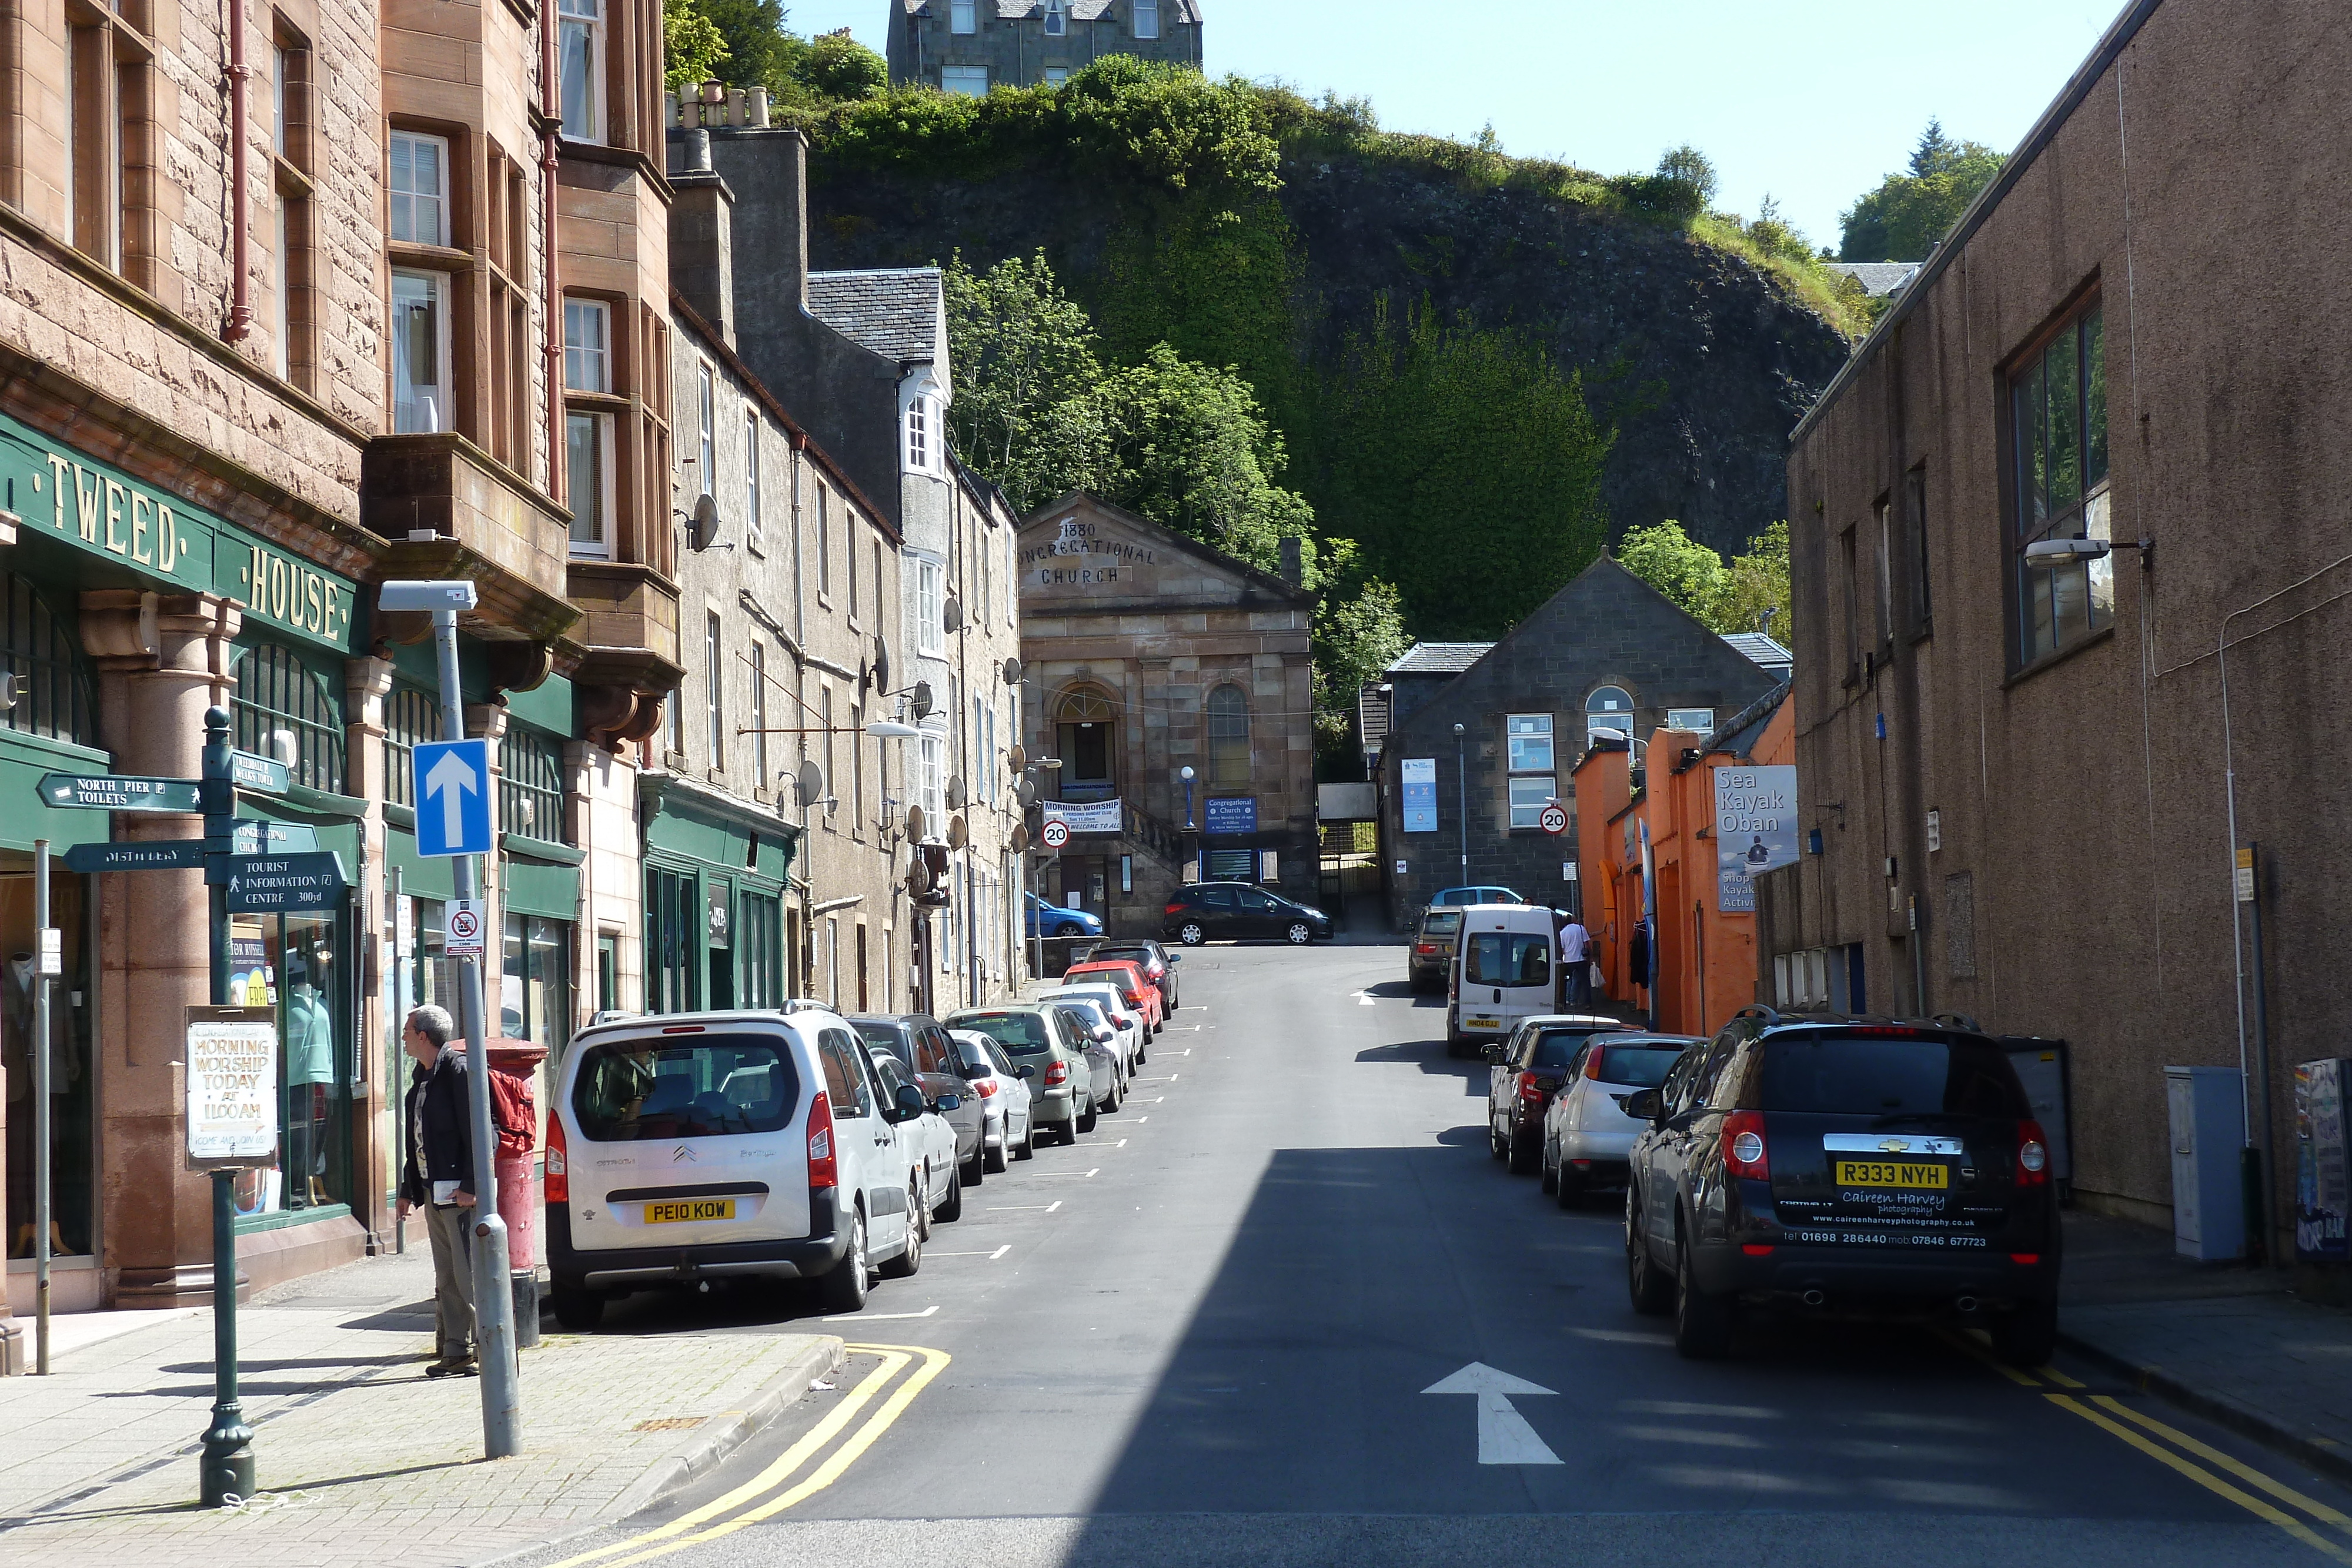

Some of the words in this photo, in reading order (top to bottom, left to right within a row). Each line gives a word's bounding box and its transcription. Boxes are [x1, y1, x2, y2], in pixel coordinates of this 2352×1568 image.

[1064, 523, 1095, 537] 1880
[48, 452, 176, 573] TWEED
[250, 545, 339, 641] HOUSE
[1017, 540, 1155, 567] ONGREGATIONAL
[1042, 569, 1118, 584] CHURCH
[76, 778, 116, 792] NORTH
[123, 781, 150, 794] PIER
[256, 774, 273, 787] TOWER
[1719, 770, 1756, 789] Sea
[76, 791, 128, 805] TOILETS
[1720, 790, 1784, 814] Kayak
[1045, 802, 1081, 811] MORNING
[1083, 801, 1119, 811] WORSHIP
[1545, 814, 1564, 827] 20
[1721, 813, 1778, 832] Oban
[238, 827, 287, 841] CONGREGATIONAL
[1047, 828, 1065, 841] 20
[246, 861, 289, 873] TOURIST
[246, 875, 317, 888] INFORMATION
[1723, 873, 1750, 884] Shop
[246, 892, 285, 904] CENTRE
[298, 891, 322, 904] 300yd
[1723, 897, 1755, 908] Activi
[244, 944, 265, 956] RUSSELL
[195, 1039, 269, 1055] MORNING
[195, 1057, 269, 1072] WORSHIP
[203, 1074, 260, 1090] TODAY
[222, 1091, 239, 1101] AT
[220, 1136, 235, 1145] AND
[236, 1135, 253, 1145] JOIN
[1844, 1163, 1896, 1183] R333
[1901, 1165, 1939, 1185] NYH
[1843, 1190, 1893, 1204] Caireen
[1897, 1193, 1945, 1211] Harvey
[654, 1203, 689, 1221] PE10
[694, 1202, 726, 1218] KOW
[1877, 1204, 1933, 1216] photography
[1813, 1215, 1975, 1227] www.caireenharveyphotography.co.uk
[1801, 1232, 1836, 1242] 01698
[1843, 1234, 1887, 1244] 286440
[1912, 1236, 1945, 1246] 07846
[1950, 1237, 1986, 1247] 677723
